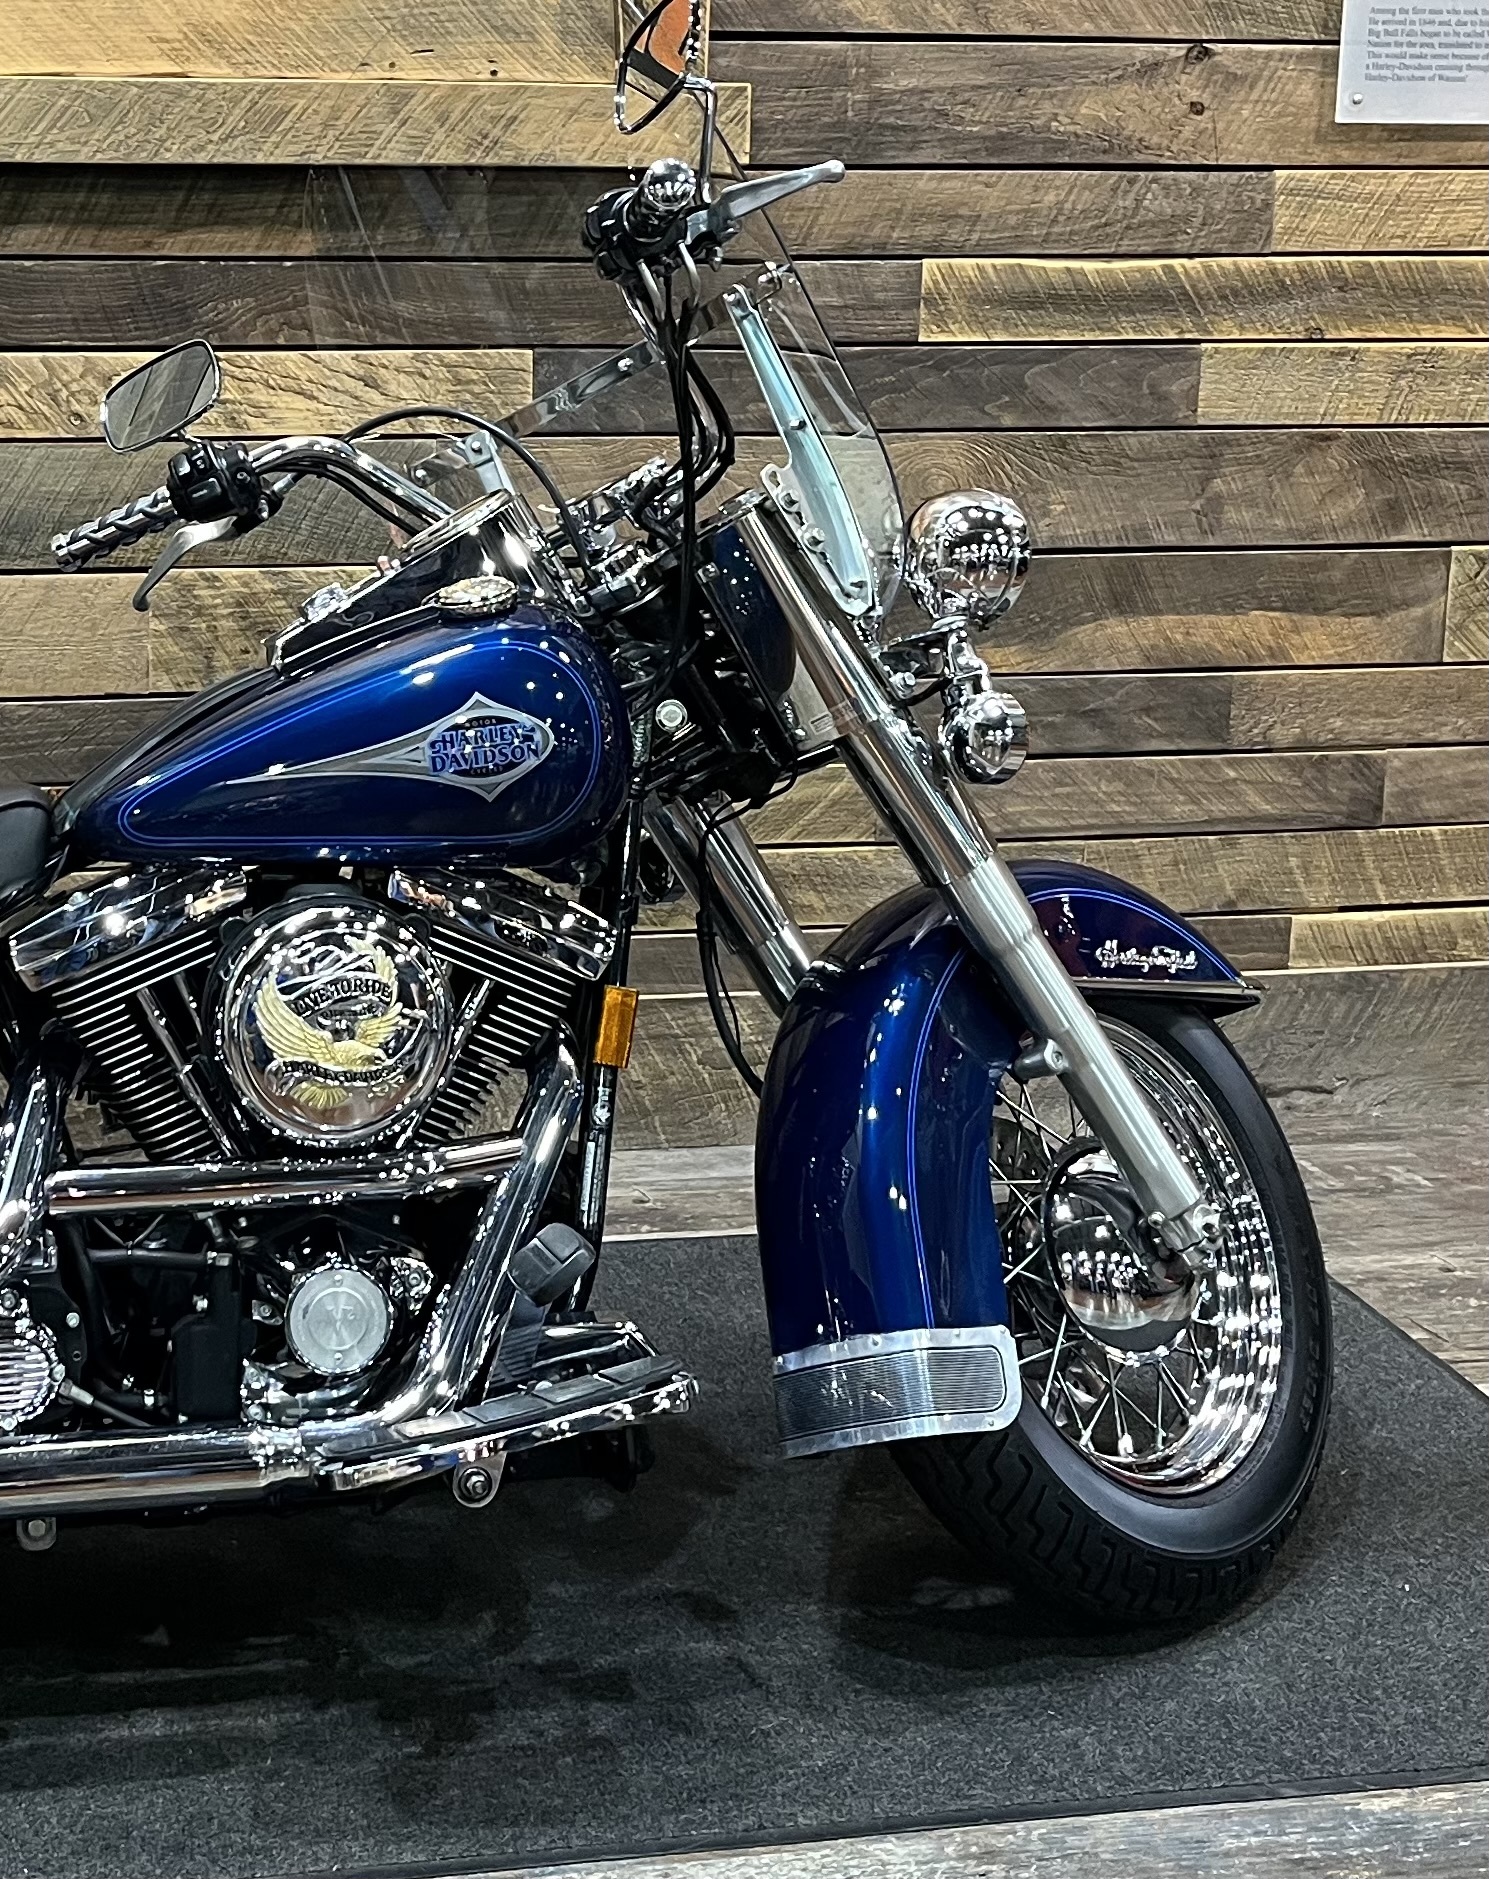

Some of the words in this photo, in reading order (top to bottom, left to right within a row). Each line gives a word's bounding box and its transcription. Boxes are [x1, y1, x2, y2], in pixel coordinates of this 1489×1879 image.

[430, 742, 541, 773] DAVIDSON
[330, 978, 352, 999] TO
[352, 976, 392, 999] RIDE
